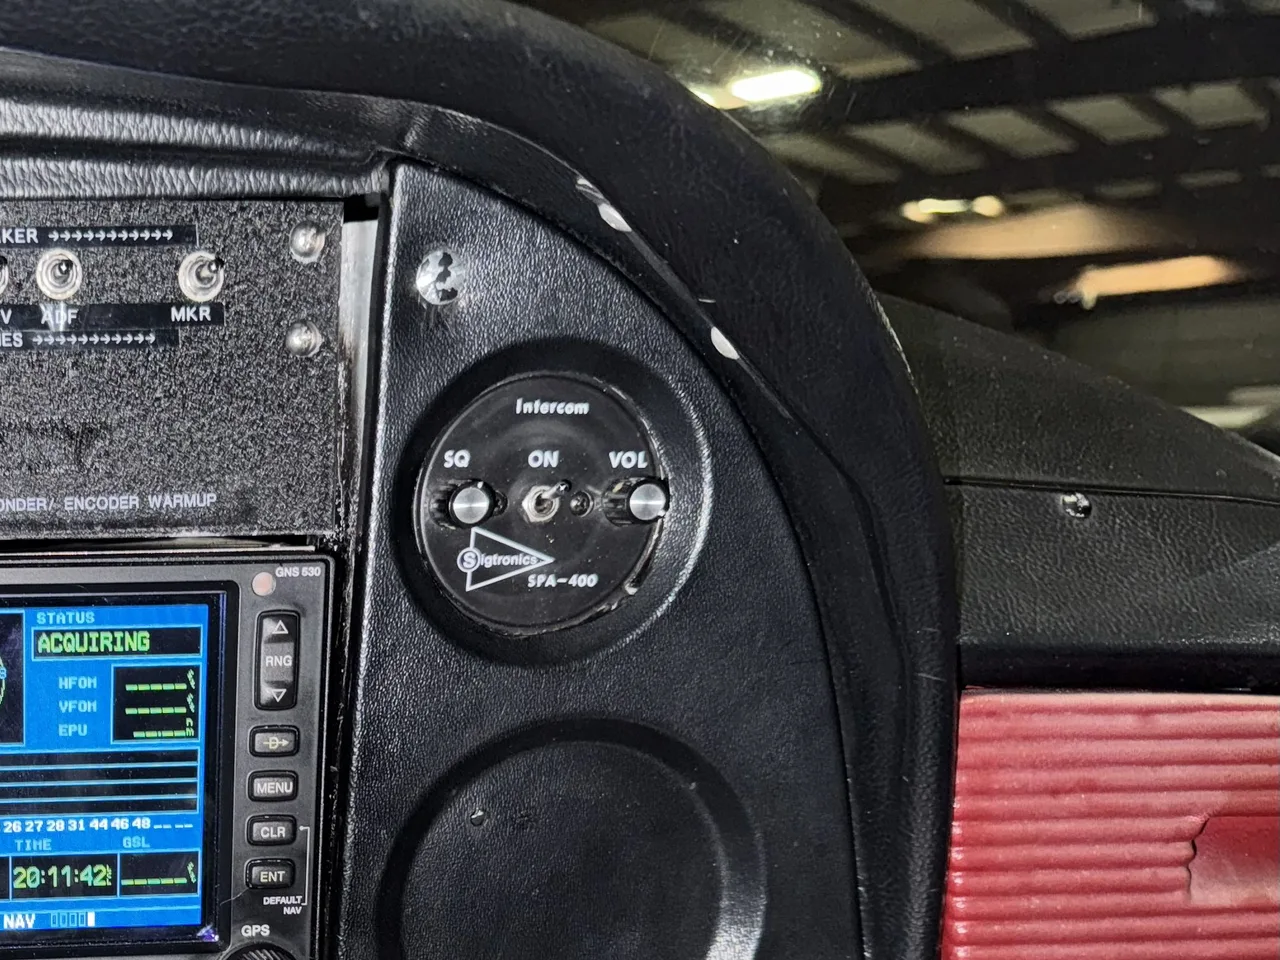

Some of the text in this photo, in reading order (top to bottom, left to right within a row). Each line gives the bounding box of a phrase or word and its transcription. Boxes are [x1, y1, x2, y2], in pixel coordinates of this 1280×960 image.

[171, 306, 211, 322] MKR
[515, 399, 590, 415] Intercom
[443, 450, 471, 468] SQ
[528, 450, 559, 468] ON
[609, 451, 648, 469] VOL
[64, 495, 140, 512] ENCODER
[148, 492, 217, 510] WARMUP
[457, 547, 538, 573] Sigtronics
[275, 565, 322, 578] GNS 530
[527, 574, 599, 589] SPA-400
[36, 611, 96, 625] STATUS
[37, 630, 151, 654] ACQUIRING
[265, 655, 293, 668] RNG
[58, 723, 88, 737] EPU
[256, 780, 294, 794] MENU
[260, 825, 287, 839] CLR
[122, 835, 151, 849] GSL
[12, 864, 107, 890] 20:11:42
[260, 869, 286, 883] ENT
[262, 896, 303, 906] DEFAULT
[3, 913, 36, 930] NAV
[240, 925, 271, 938] GPS
